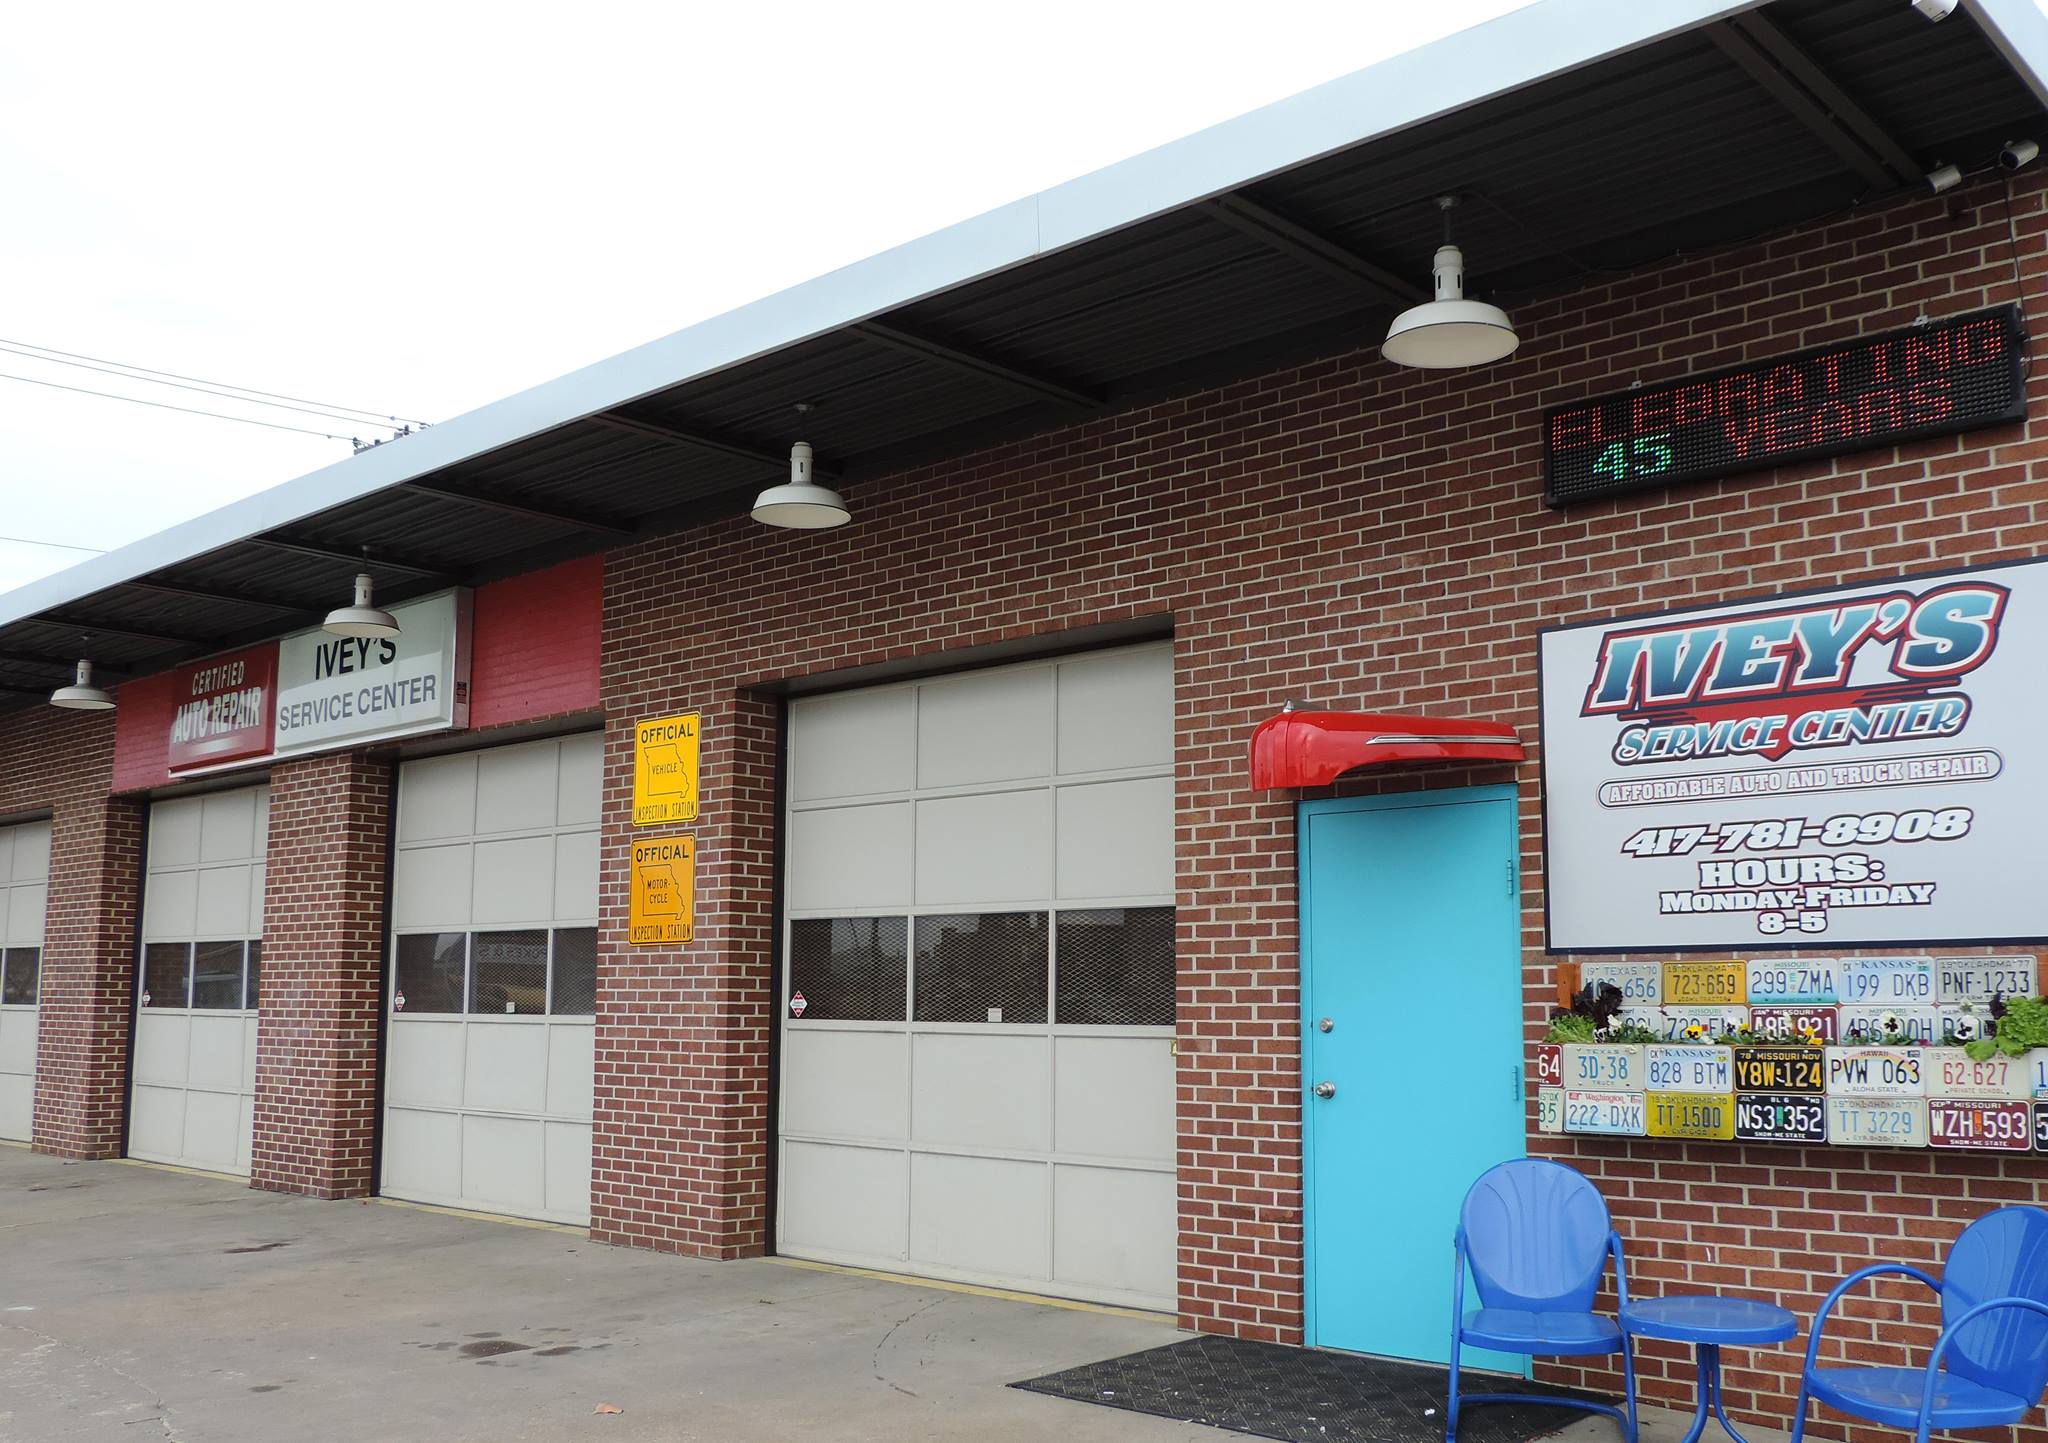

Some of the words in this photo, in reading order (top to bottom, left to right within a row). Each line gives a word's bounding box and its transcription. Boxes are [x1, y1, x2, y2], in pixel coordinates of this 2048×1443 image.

[1593, 433, 1672, 480] 45
[1724, 378, 1952, 458] YEARS
[315, 637, 397, 681] IVEY'S
[1586, 585, 2005, 711] IVEY'S
[192, 661, 244, 696] CERTIFIED
[279, 693, 353, 731] SERVICE
[357, 674, 437, 715] CENTER
[174, 698, 209, 744] AUTO
[211, 686, 262, 735] REPAIR
[641, 722, 694, 744] OFFICIAL
[1616, 714, 1787, 760] SERVICE
[1787, 697, 1969, 748] CENTER
[651, 762, 678, 775] VEHICLE
[1609, 777, 1726, 803] AFFORDABLE
[1730, 772, 1783, 794] AUTO
[1787, 769, 1828, 790] AND
[1833, 762, 1904, 785] TRUCK
[1907, 756, 1989, 780] REPAIR
[636, 804, 668, 821] INSPECTION
[671, 802, 695, 818] STATION
[1622, 807, 1974, 858] 417-781-8908
[636, 844, 689, 863] OFFICIAL
[1699, 852, 1886, 890] HOURS:
[649, 892, 668, 904] CYCLE
[1660, 882, 1937, 915] MONDAY-FRIDAY
[631, 924, 663, 941] INSPECTION
[666, 922, 691, 939] STATION
[1757, 910, 1829, 935] 8-5
[1604, 966, 1638, 976] TEXAS
[1681, 965, 1727, 973] OKLAHOMA
[1861, 960, 1913, 969] KANSAS
[1958, 960, 2012, 968] OKLAHOMA
[1624, 978, 1657, 998] 656
[1752, 970, 1787, 994] 299
[1797, 970, 1834, 994] ZMA
[1847, 974, 1880, 997] 199
[1893, 973, 1929, 997] DKB
[1942, 970, 2030, 994] PNF-1233
[1665, 1049, 1712, 1058] KANSAS
[1757, 1052, 1800, 1061] MISSOURI
[1538, 1054, 1561, 1078] 64
[1650, 1061, 1682, 1084] 828
[1694, 1062, 1727, 1085] BTM
[1831, 1058, 1868, 1084] PVW
[1882, 1058, 1920, 1084] 063
[1584, 1093, 1626, 1104] Washington
[1954, 1101, 2002, 1109] MISSOURI
[1737, 1103, 1776, 1131] NS3
[1783, 1105, 1823, 1133] 352
[1839, 1110, 1859, 1133] TT
[1867, 1111, 1912, 1134] 3229
[1931, 1109, 1974, 1138] WZH
[1982, 1111, 2027, 1139] 593
